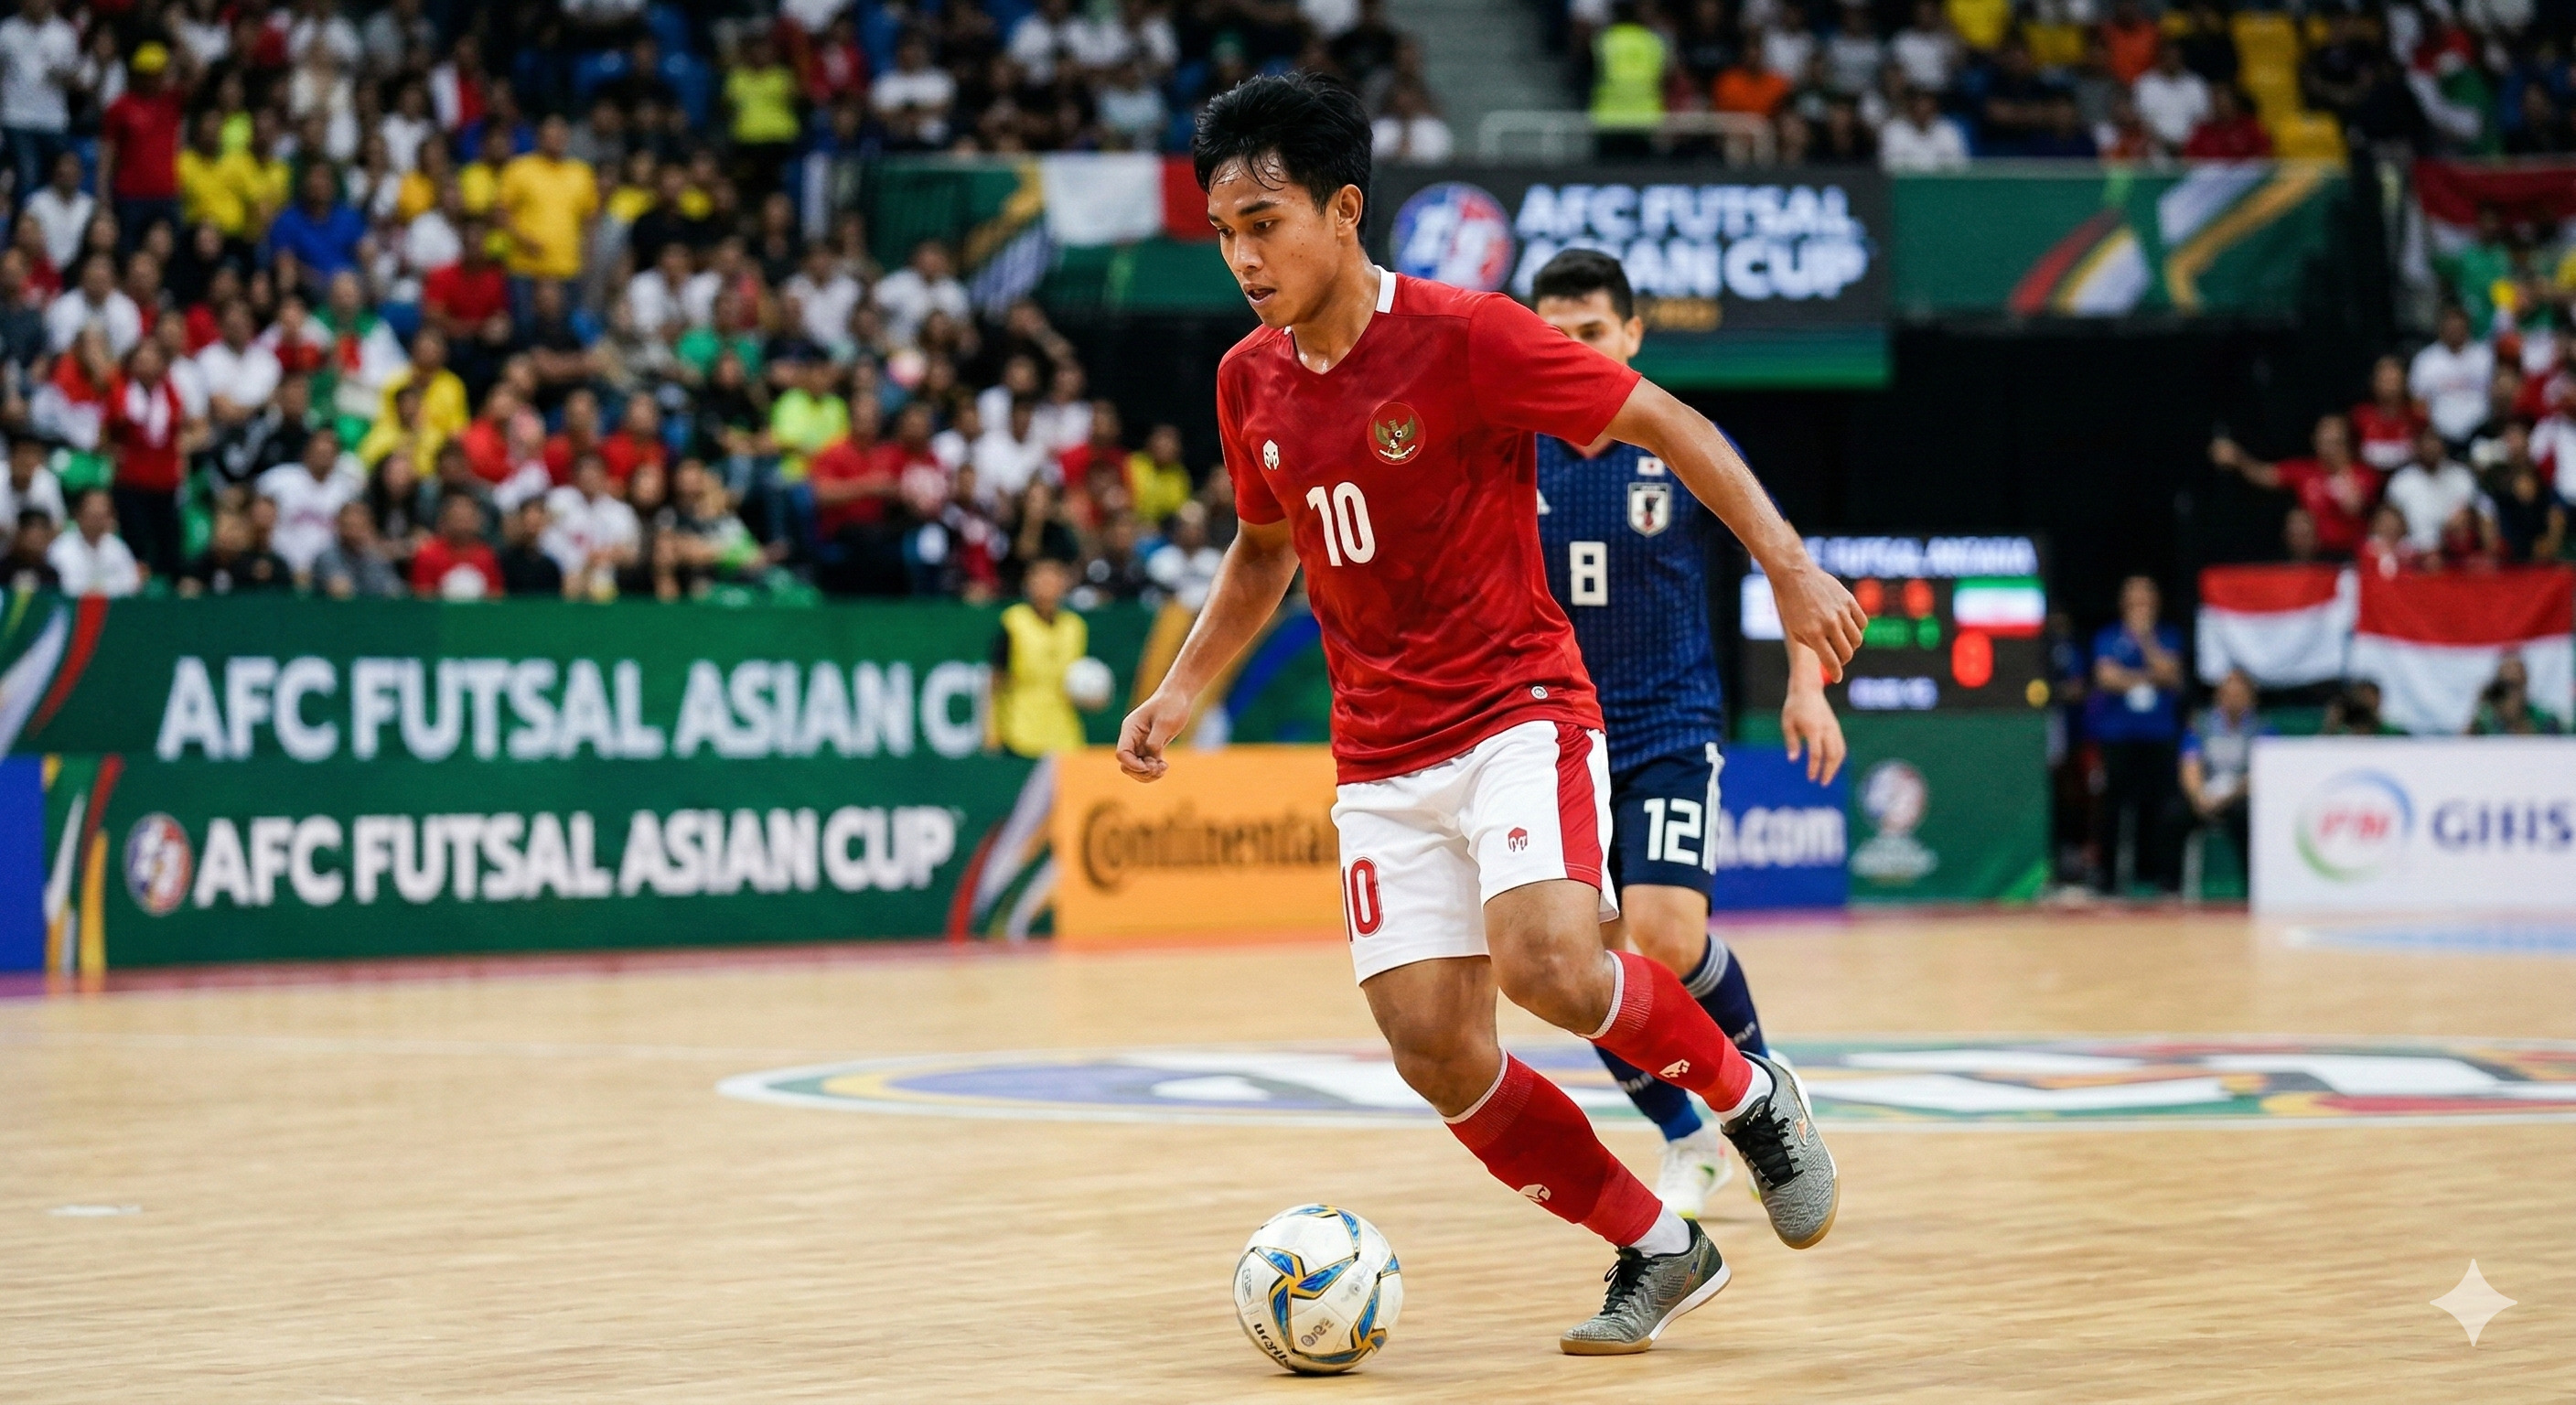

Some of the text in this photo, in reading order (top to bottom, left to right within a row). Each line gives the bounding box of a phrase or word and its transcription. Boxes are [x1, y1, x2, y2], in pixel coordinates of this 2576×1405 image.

[1513, 183, 1851, 240] AFC FUTSAL
[1724, 234, 1869, 300] CUP
[1305, 481, 1375, 567] 10
[1570, 542, 1608, 606] 8
[157, 656, 338, 761] AFC
[351, 657, 665, 760] FUTSAL
[672, 659, 915, 759] ASIAN
[194, 805, 957, 908] AFC FUTSAL ASIAN CUP
[1644, 798, 1702, 865] 12
